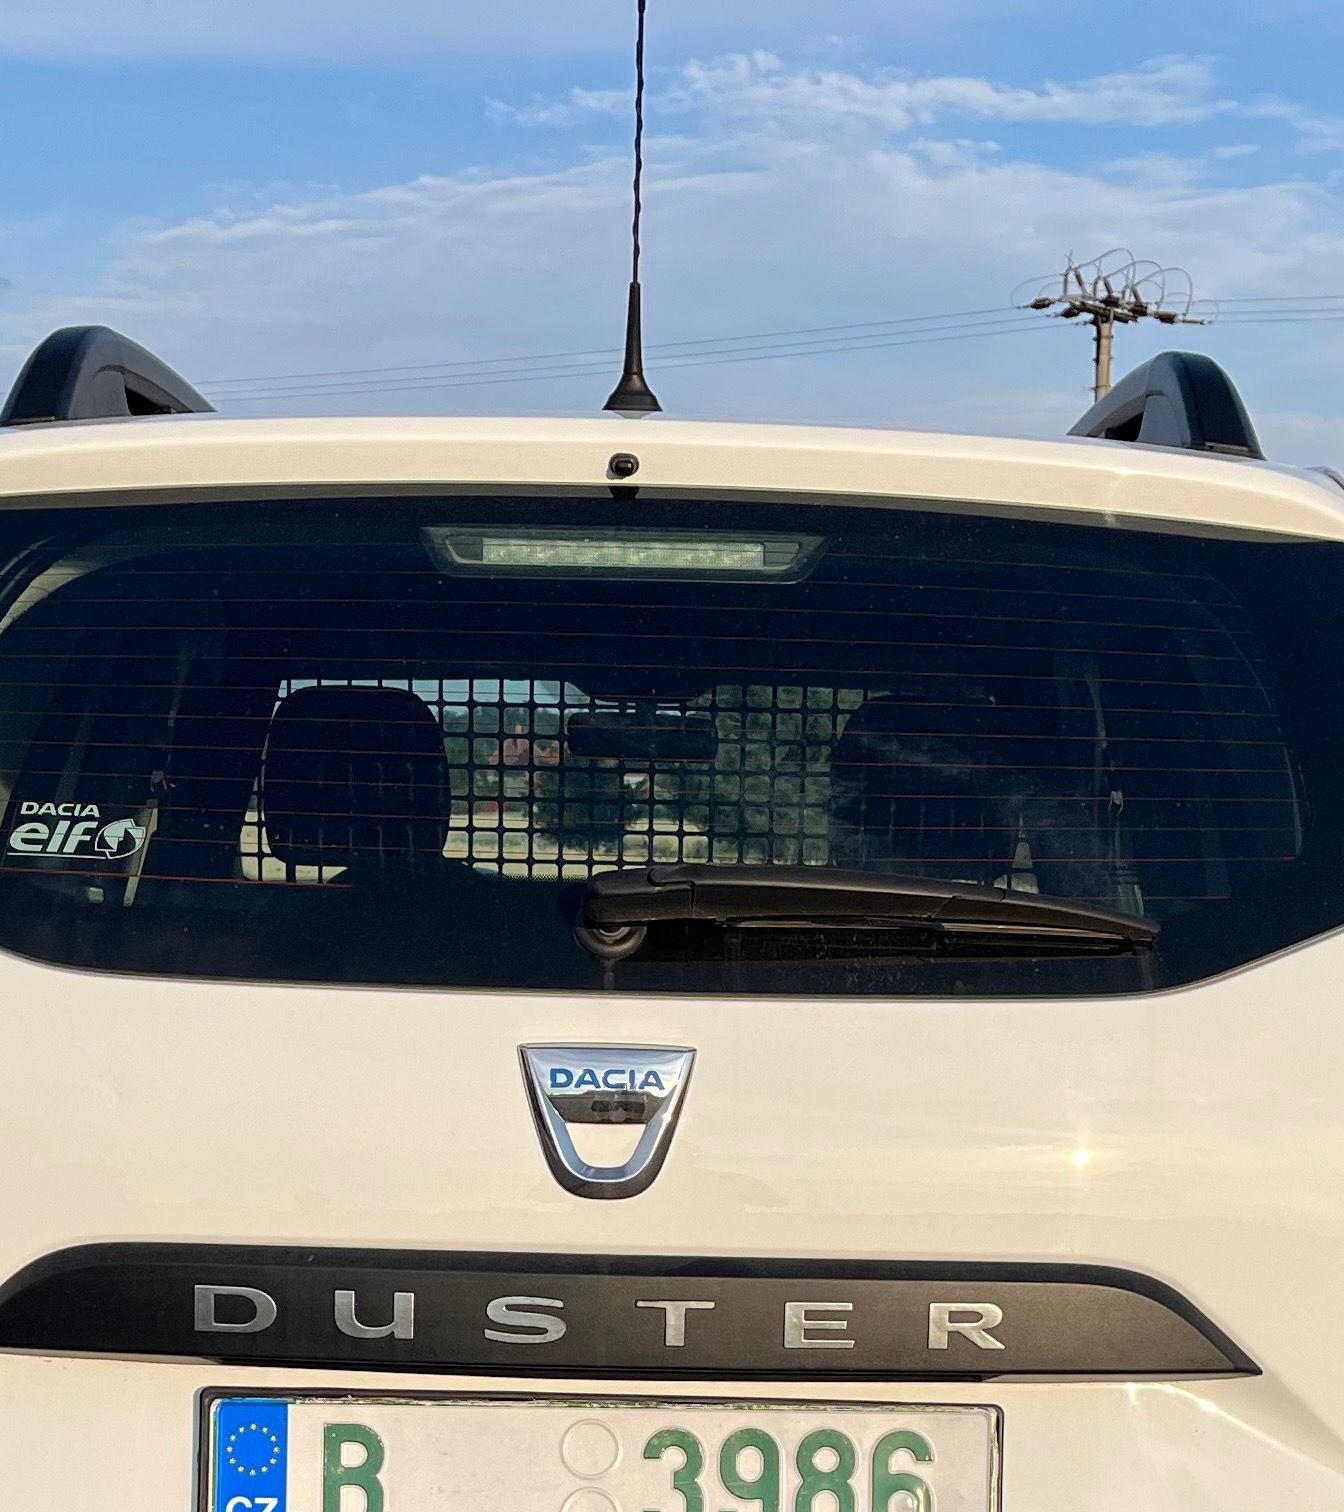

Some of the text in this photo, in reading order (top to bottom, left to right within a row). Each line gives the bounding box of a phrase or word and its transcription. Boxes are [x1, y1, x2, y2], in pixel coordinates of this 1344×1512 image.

[20, 801, 100, 818] DACIA
[8, 821, 99, 853] elf
[549, 1068, 665, 1090] DACIA
[192, 1284, 1006, 1351] DUSTER
